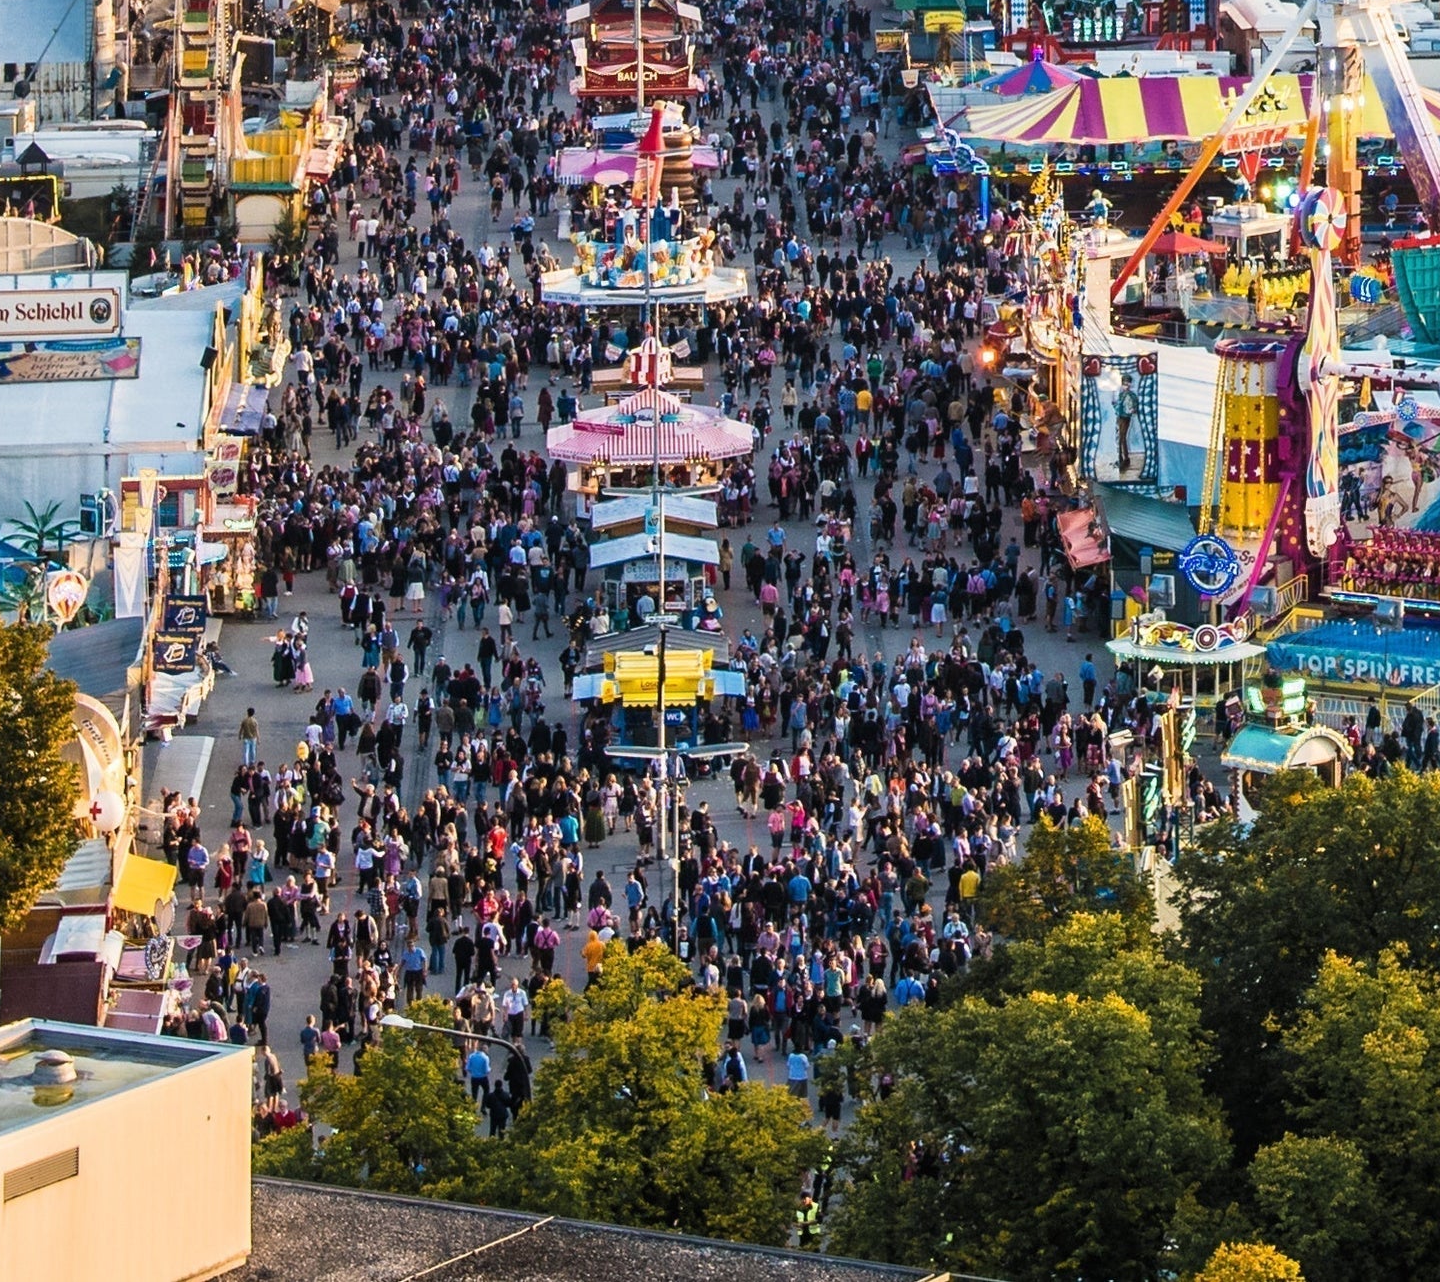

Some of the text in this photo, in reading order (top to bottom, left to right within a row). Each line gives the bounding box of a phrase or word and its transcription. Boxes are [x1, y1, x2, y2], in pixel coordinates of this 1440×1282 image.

[617, 70, 658, 82] BAUCH
[15, 301, 84, 323] Schichtl
[1297, 654, 1336, 674] TOP
[1344, 659, 1393, 679] SPIN
